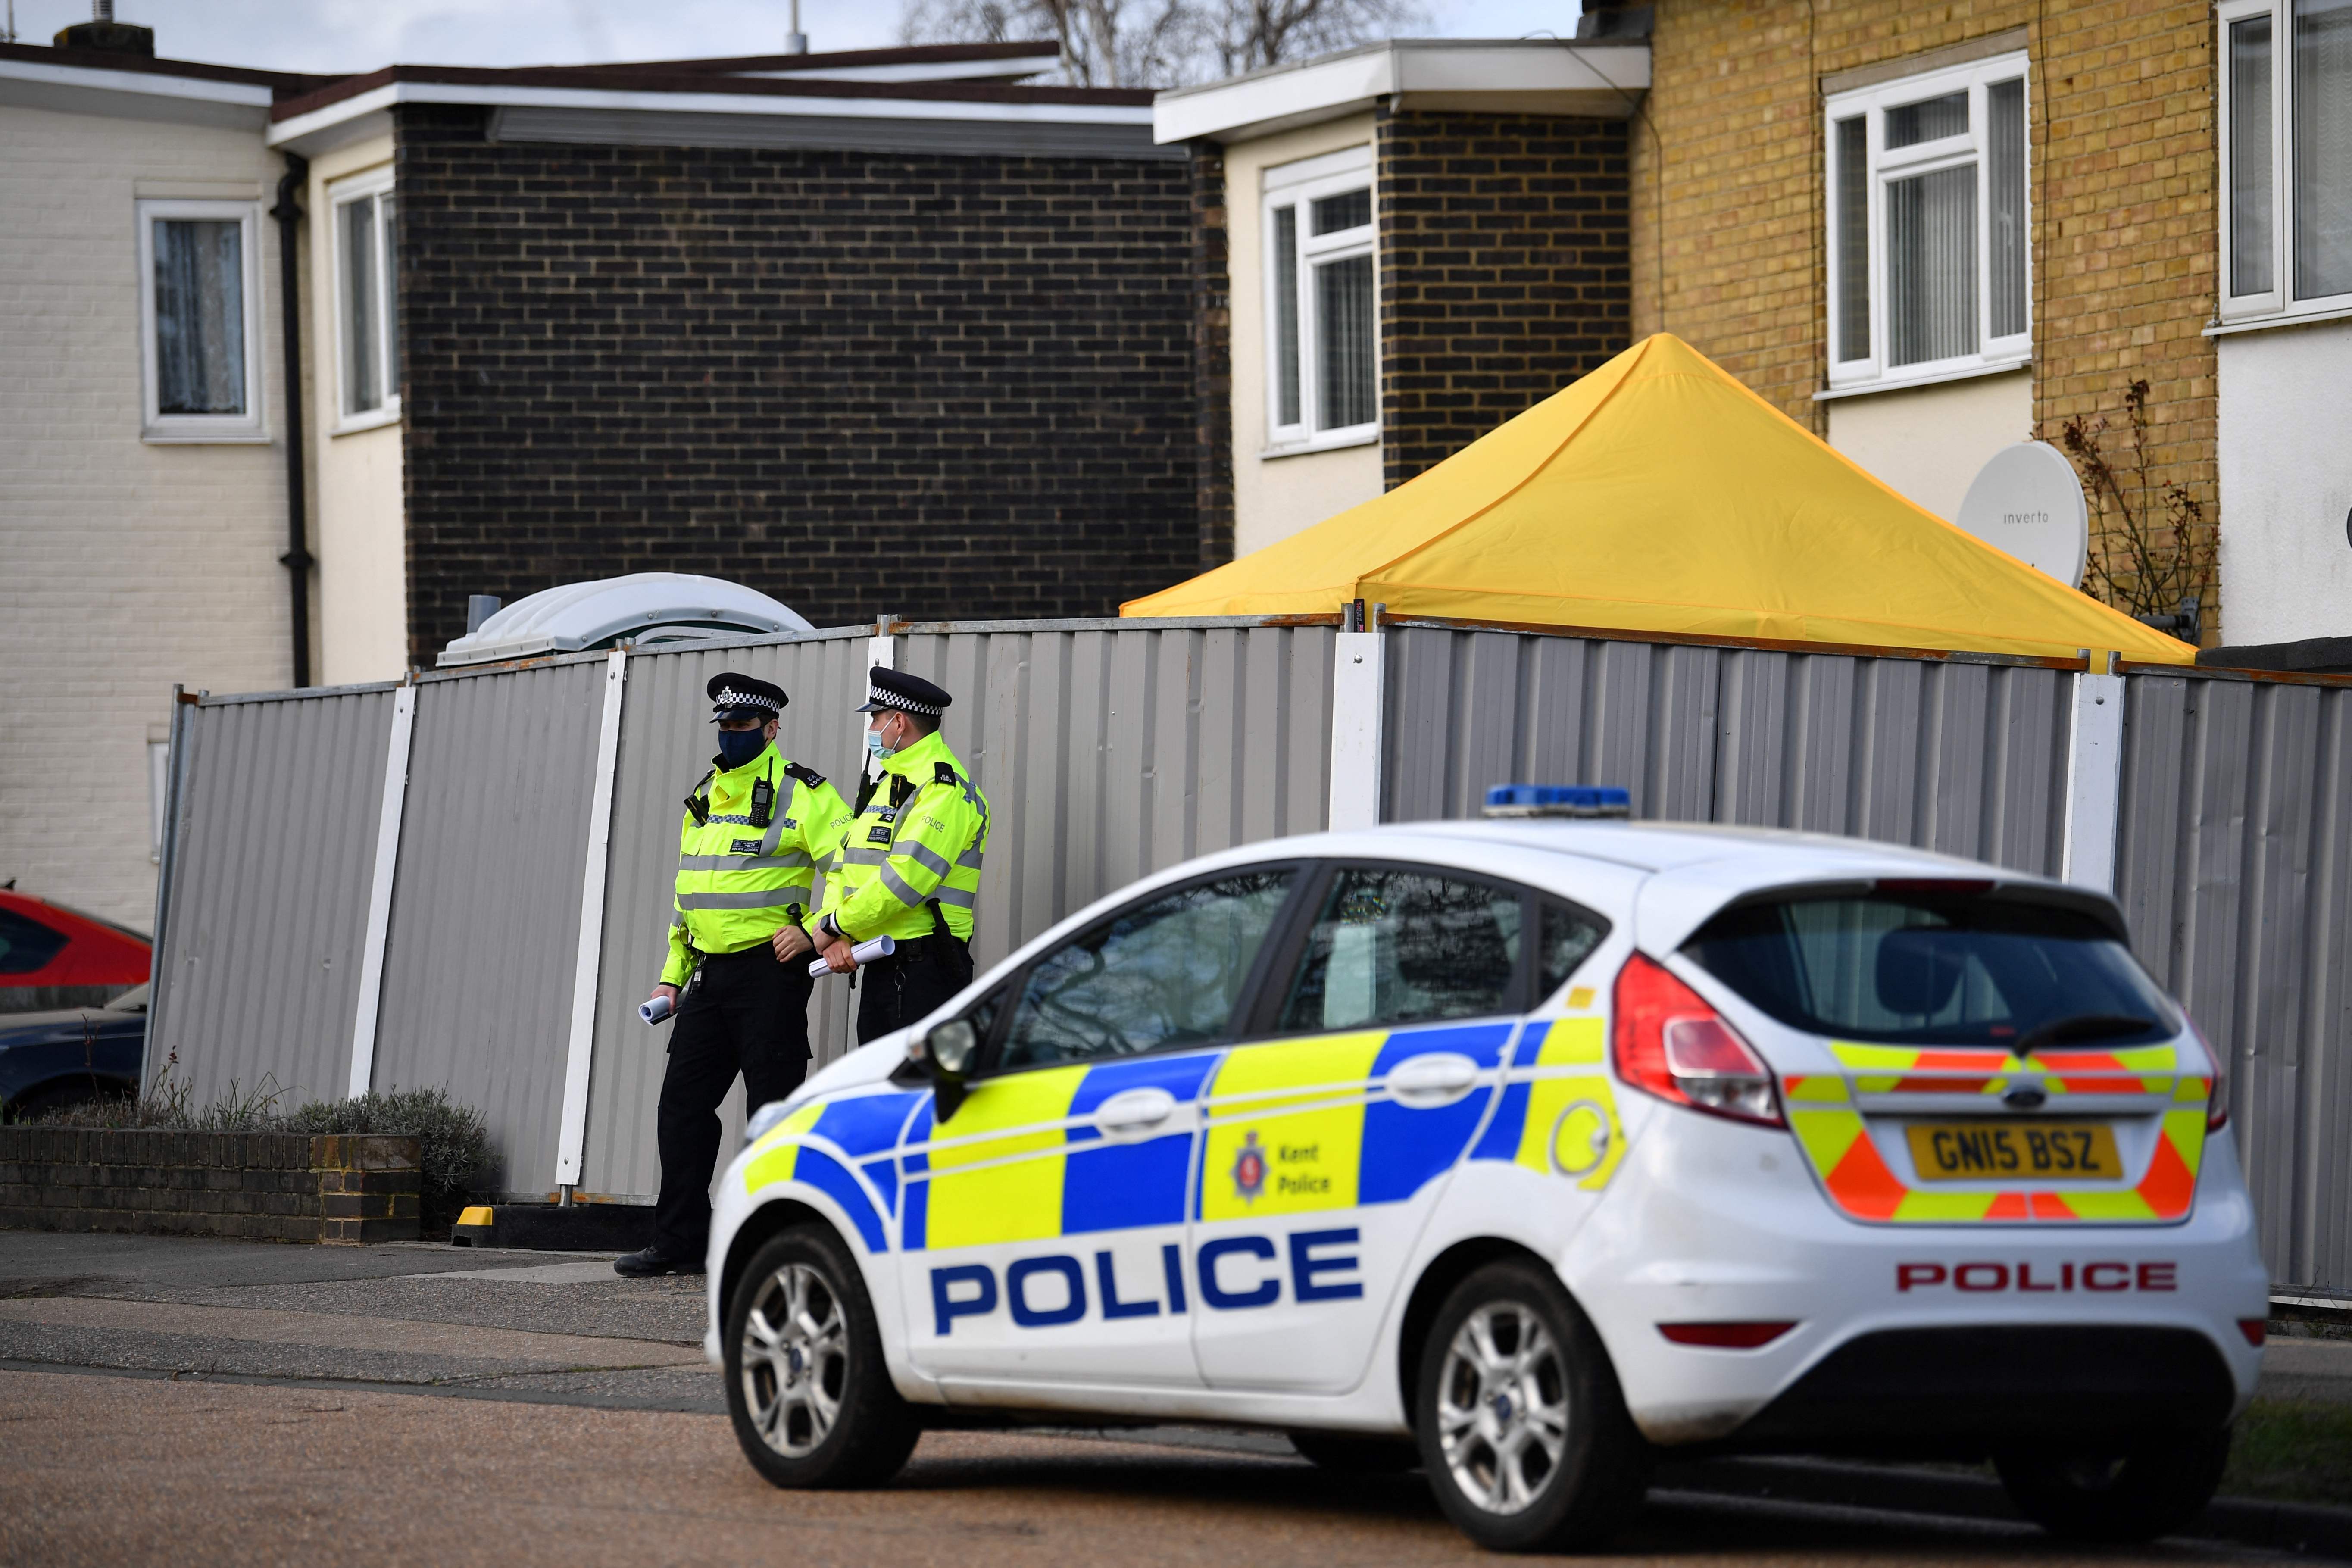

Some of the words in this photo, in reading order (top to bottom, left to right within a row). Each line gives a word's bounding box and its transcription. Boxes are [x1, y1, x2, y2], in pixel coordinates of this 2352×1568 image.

[2003, 510, 2048, 524] inverto
[830, 812, 854, 829] POLICE
[920, 816, 945, 833] POLICE
[1278, 1143, 1319, 1163] Kent
[1932, 1130, 2020, 1171] GN15
[2024, 1130, 2101, 1171] BSZ
[1278, 1174, 1331, 1195] Police
[929, 1226, 1364, 1337] POLICE
[1896, 1261, 2177, 1293] POLICE
